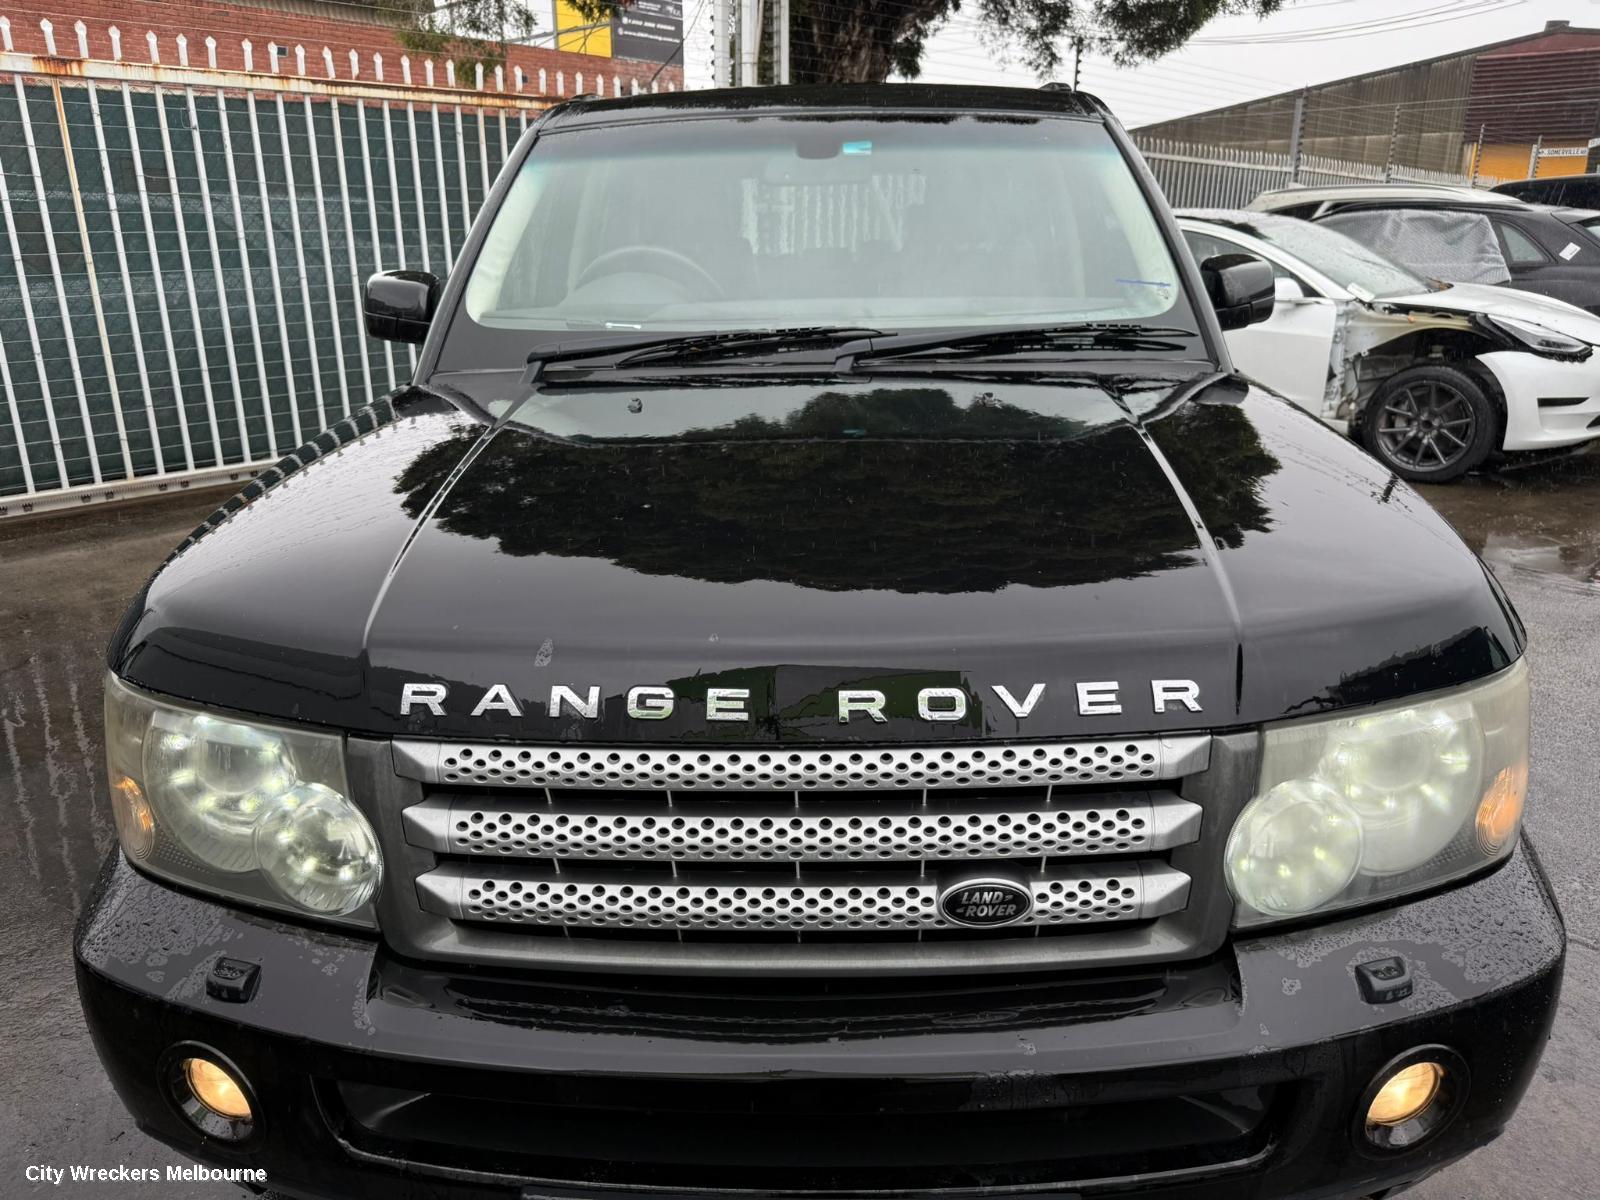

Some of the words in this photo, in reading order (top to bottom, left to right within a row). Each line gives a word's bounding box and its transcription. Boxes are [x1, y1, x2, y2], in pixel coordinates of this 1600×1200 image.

[400, 683, 750, 721] RANGE
[838, 679, 1203, 724] ROVER
[962, 891, 1004, 904] LAND
[965, 904, 1017, 917] ROVER
